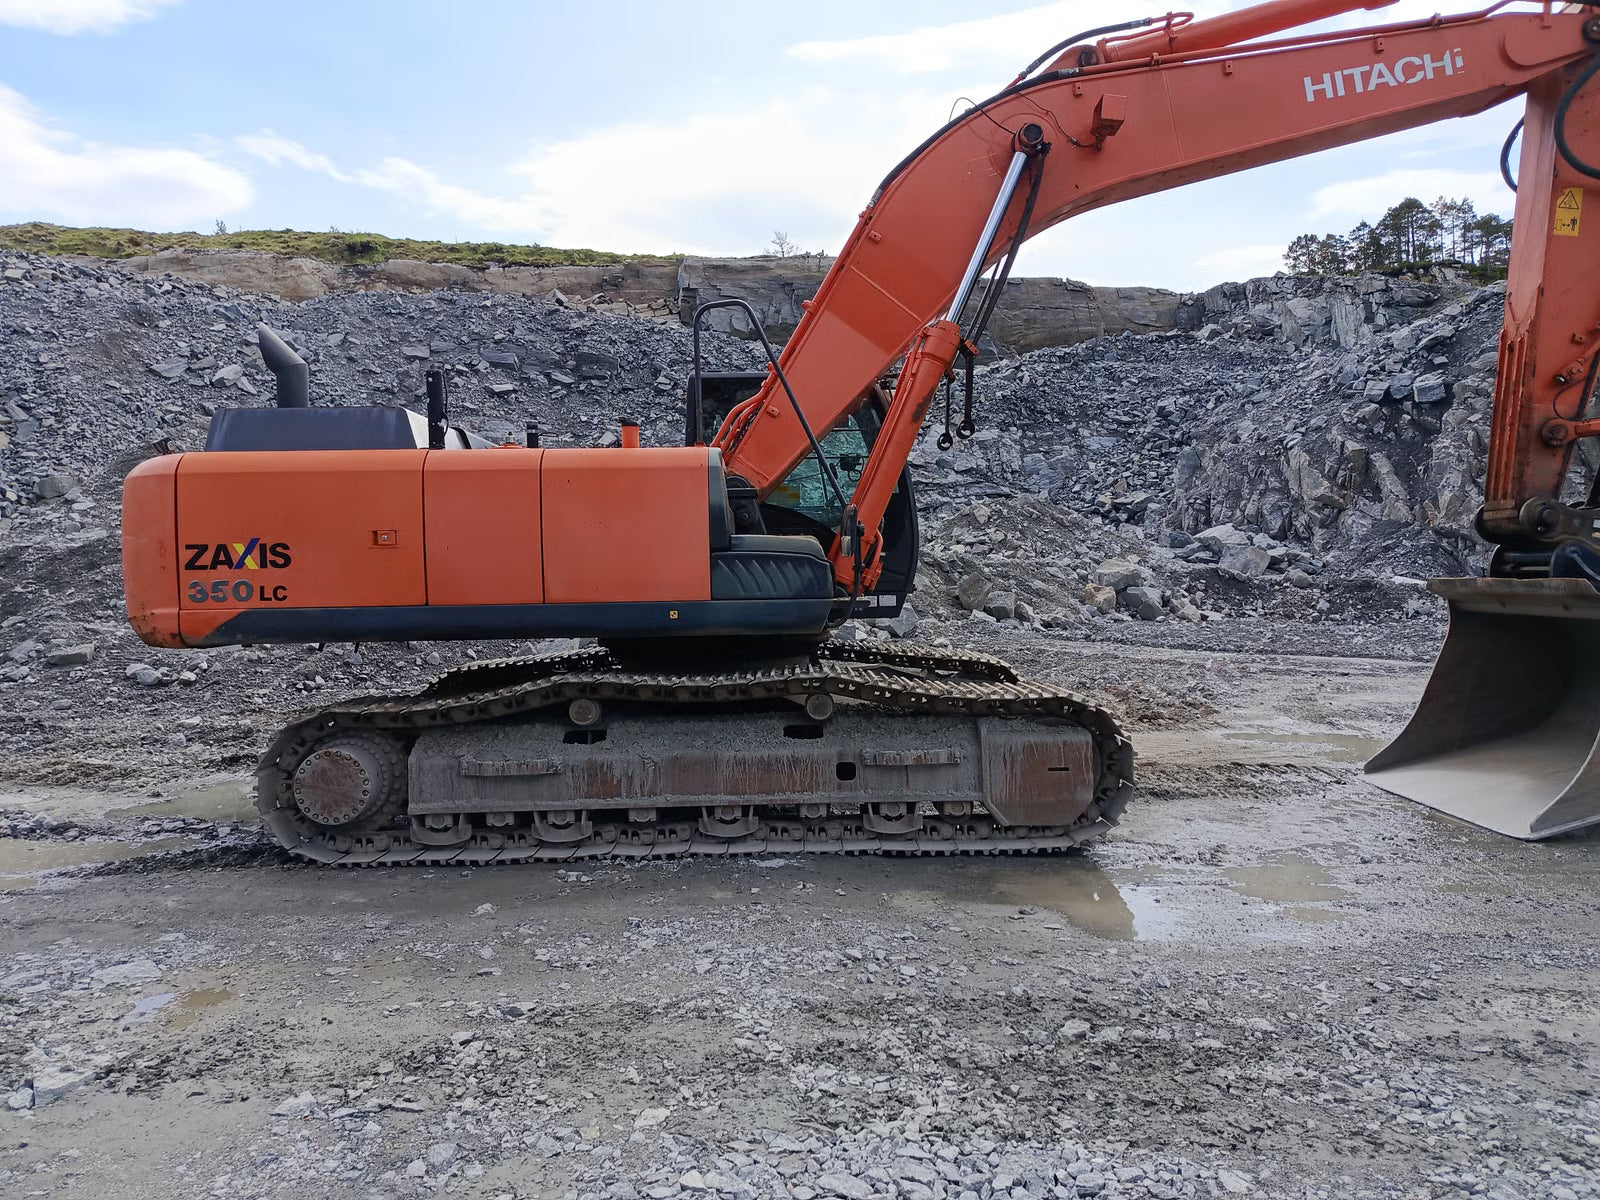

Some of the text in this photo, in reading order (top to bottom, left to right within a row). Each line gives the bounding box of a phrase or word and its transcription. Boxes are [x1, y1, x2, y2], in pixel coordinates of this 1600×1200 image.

[185, 538, 292, 570] ZAXIS
[188, 579, 288, 603] 350 LC
